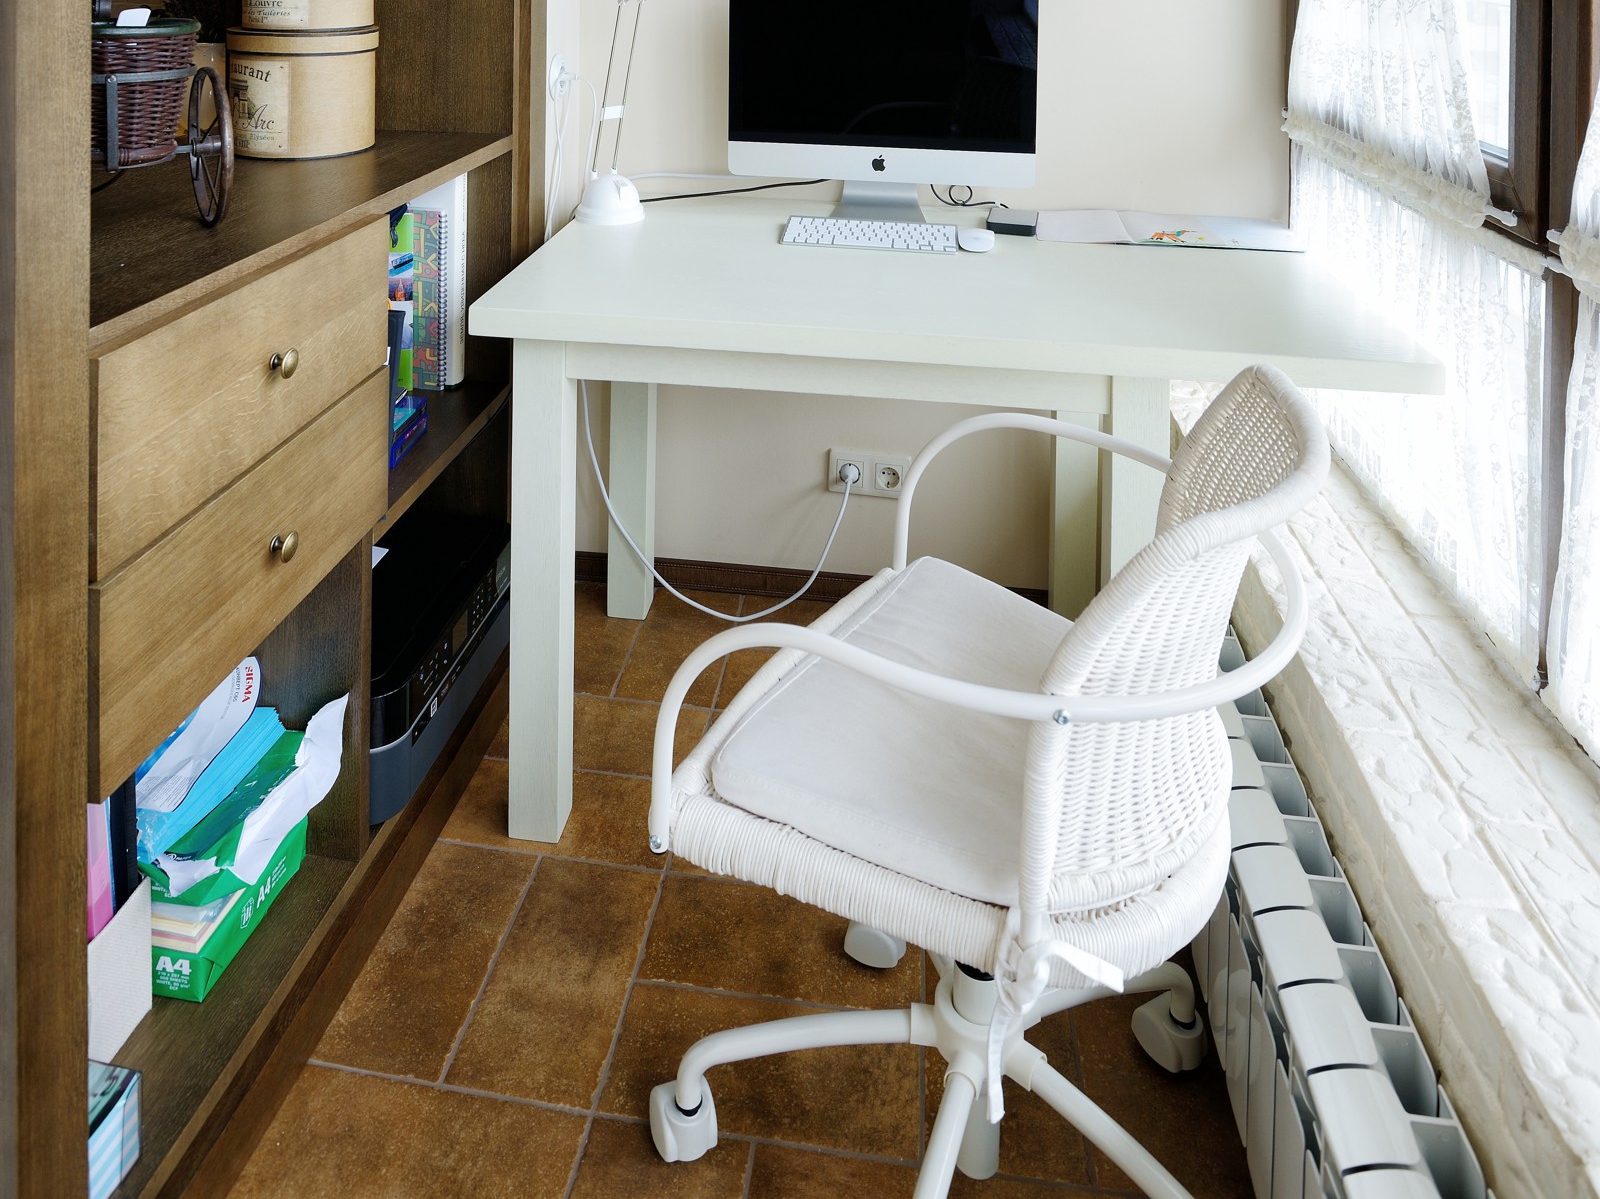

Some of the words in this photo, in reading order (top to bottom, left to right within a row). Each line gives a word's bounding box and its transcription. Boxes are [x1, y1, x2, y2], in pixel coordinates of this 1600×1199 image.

[242, 666, 254, 702] SIGMA
[256, 876, 271, 909] A4
[155, 955, 192, 975] A4
